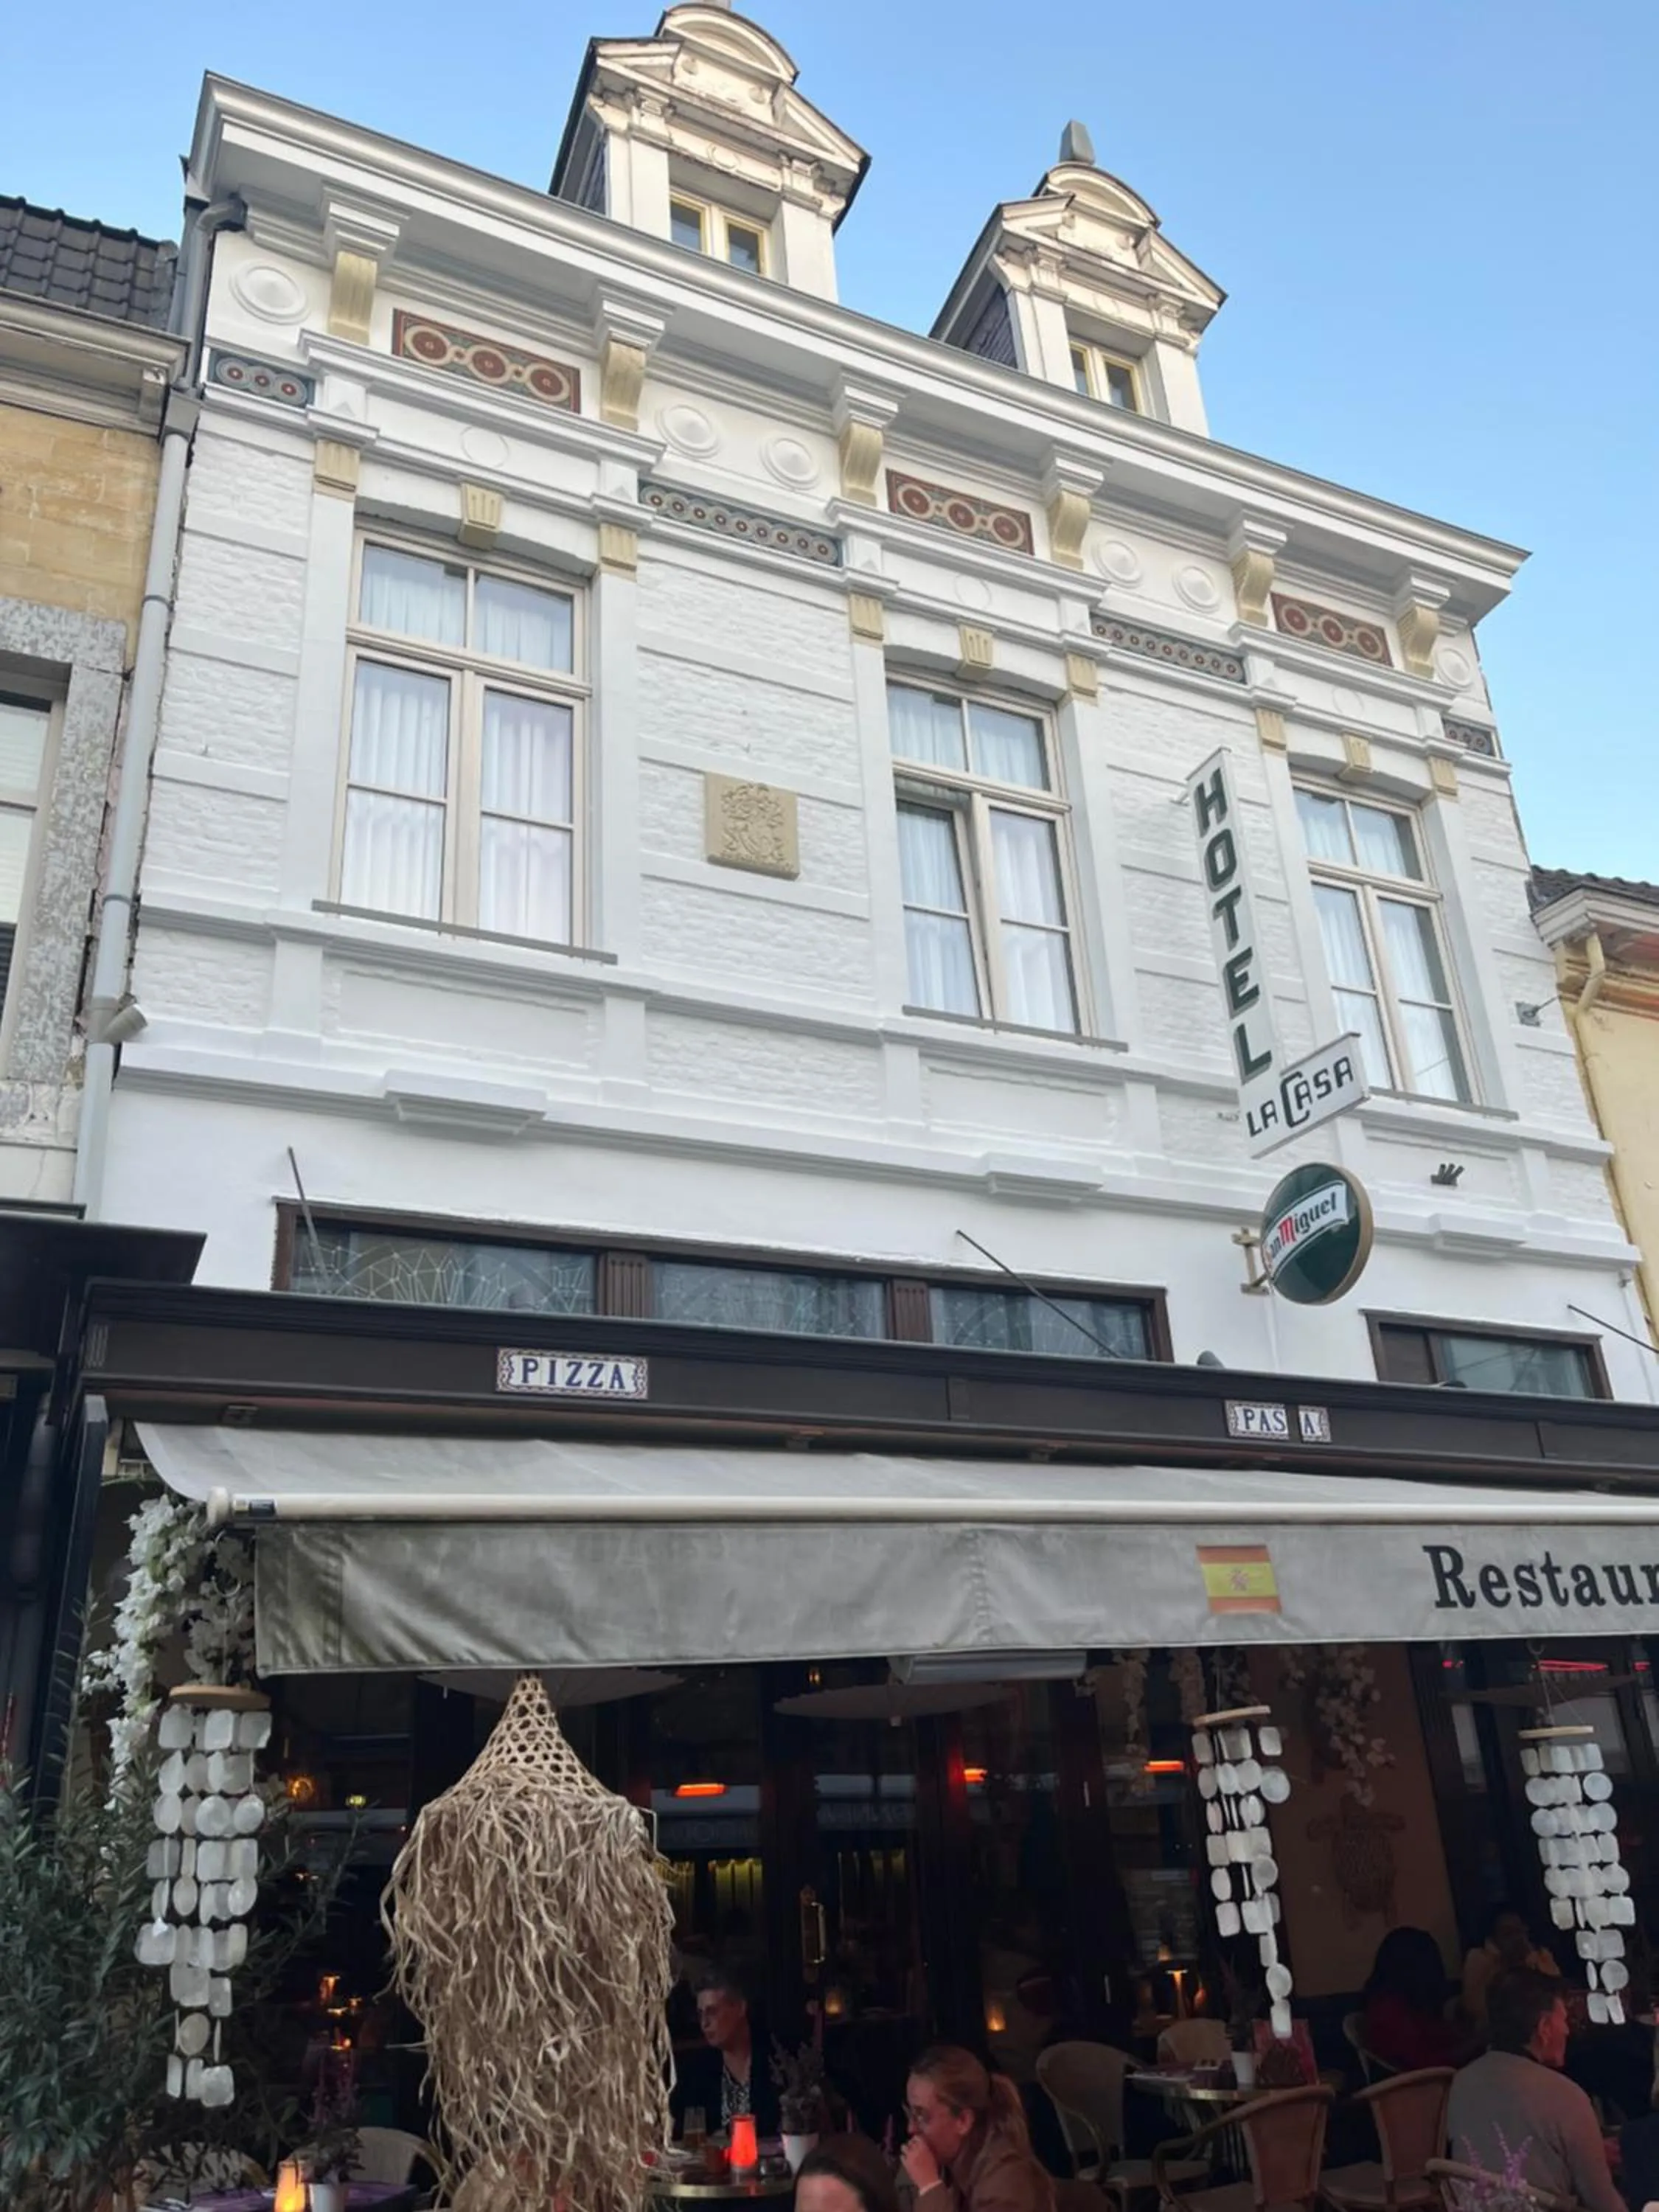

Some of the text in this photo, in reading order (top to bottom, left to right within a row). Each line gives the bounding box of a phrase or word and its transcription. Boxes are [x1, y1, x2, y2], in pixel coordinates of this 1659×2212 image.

[1194, 767, 1272, 1086] HOTEL
[1246, 1056, 1354, 1138] LA CASA
[1278, 1191, 1337, 1246] Miguel
[521, 1357, 625, 1389] PIZZA
